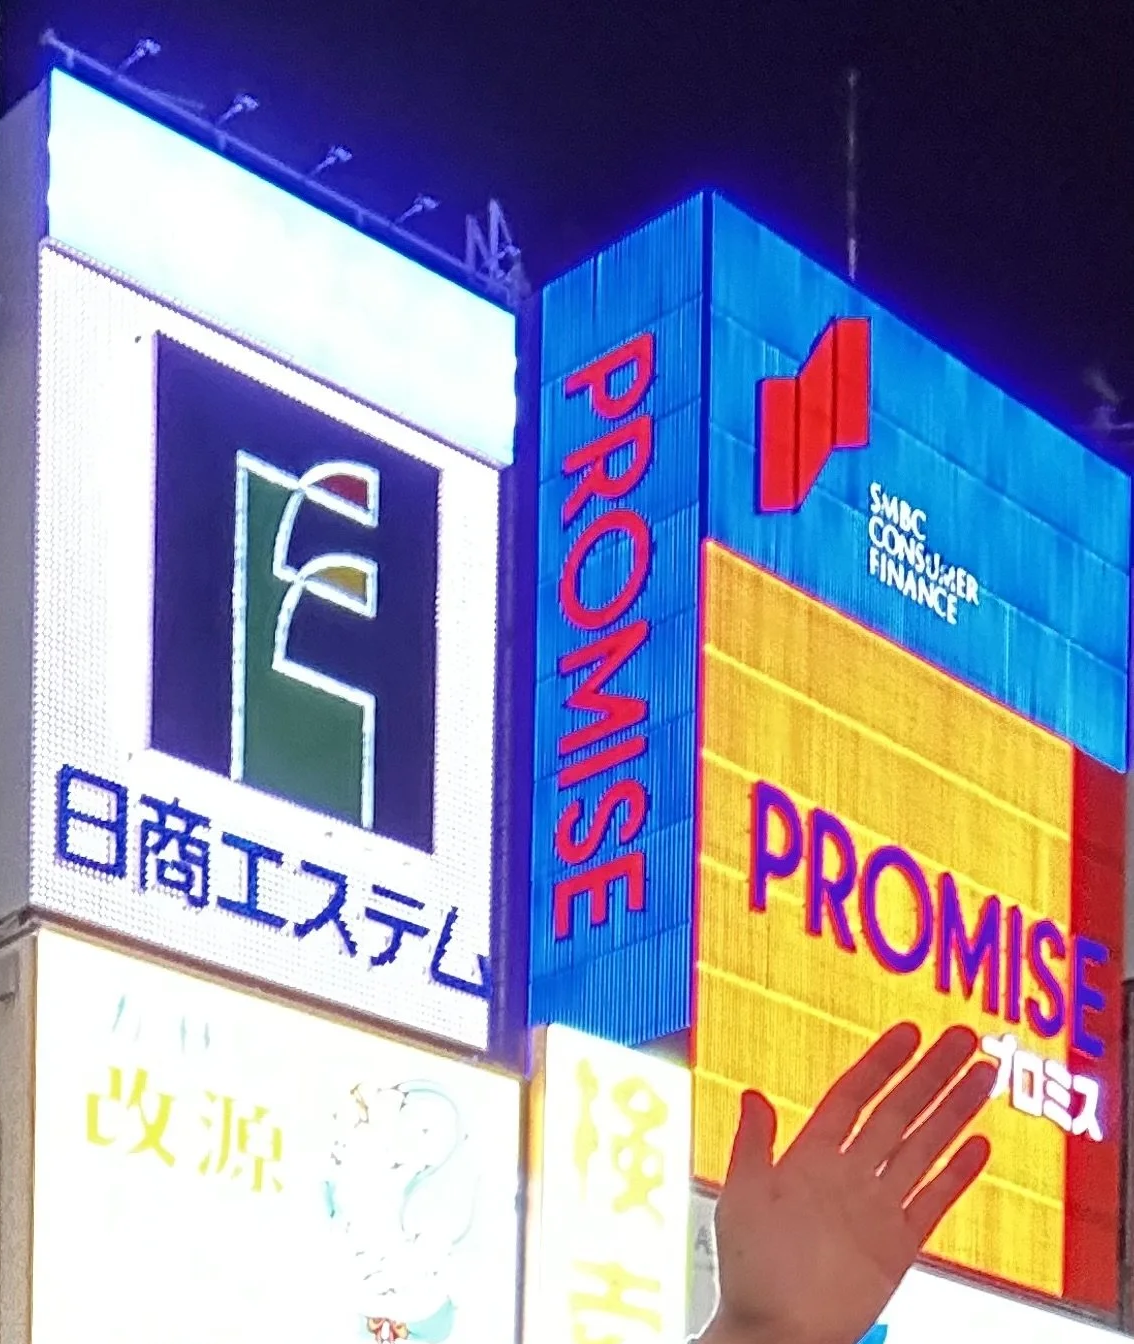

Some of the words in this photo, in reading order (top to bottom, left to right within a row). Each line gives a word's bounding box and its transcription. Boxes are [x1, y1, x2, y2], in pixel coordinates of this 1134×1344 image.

[868, 515, 979, 606] CONSUMER
[869, 546, 958, 625] FINANCE
[870, 481, 927, 541] SMBC
[551, 330, 656, 942] PROMISE
[56, 763, 493, 998] 日商エステム
[747, 779, 1112, 1060] PROMISE
